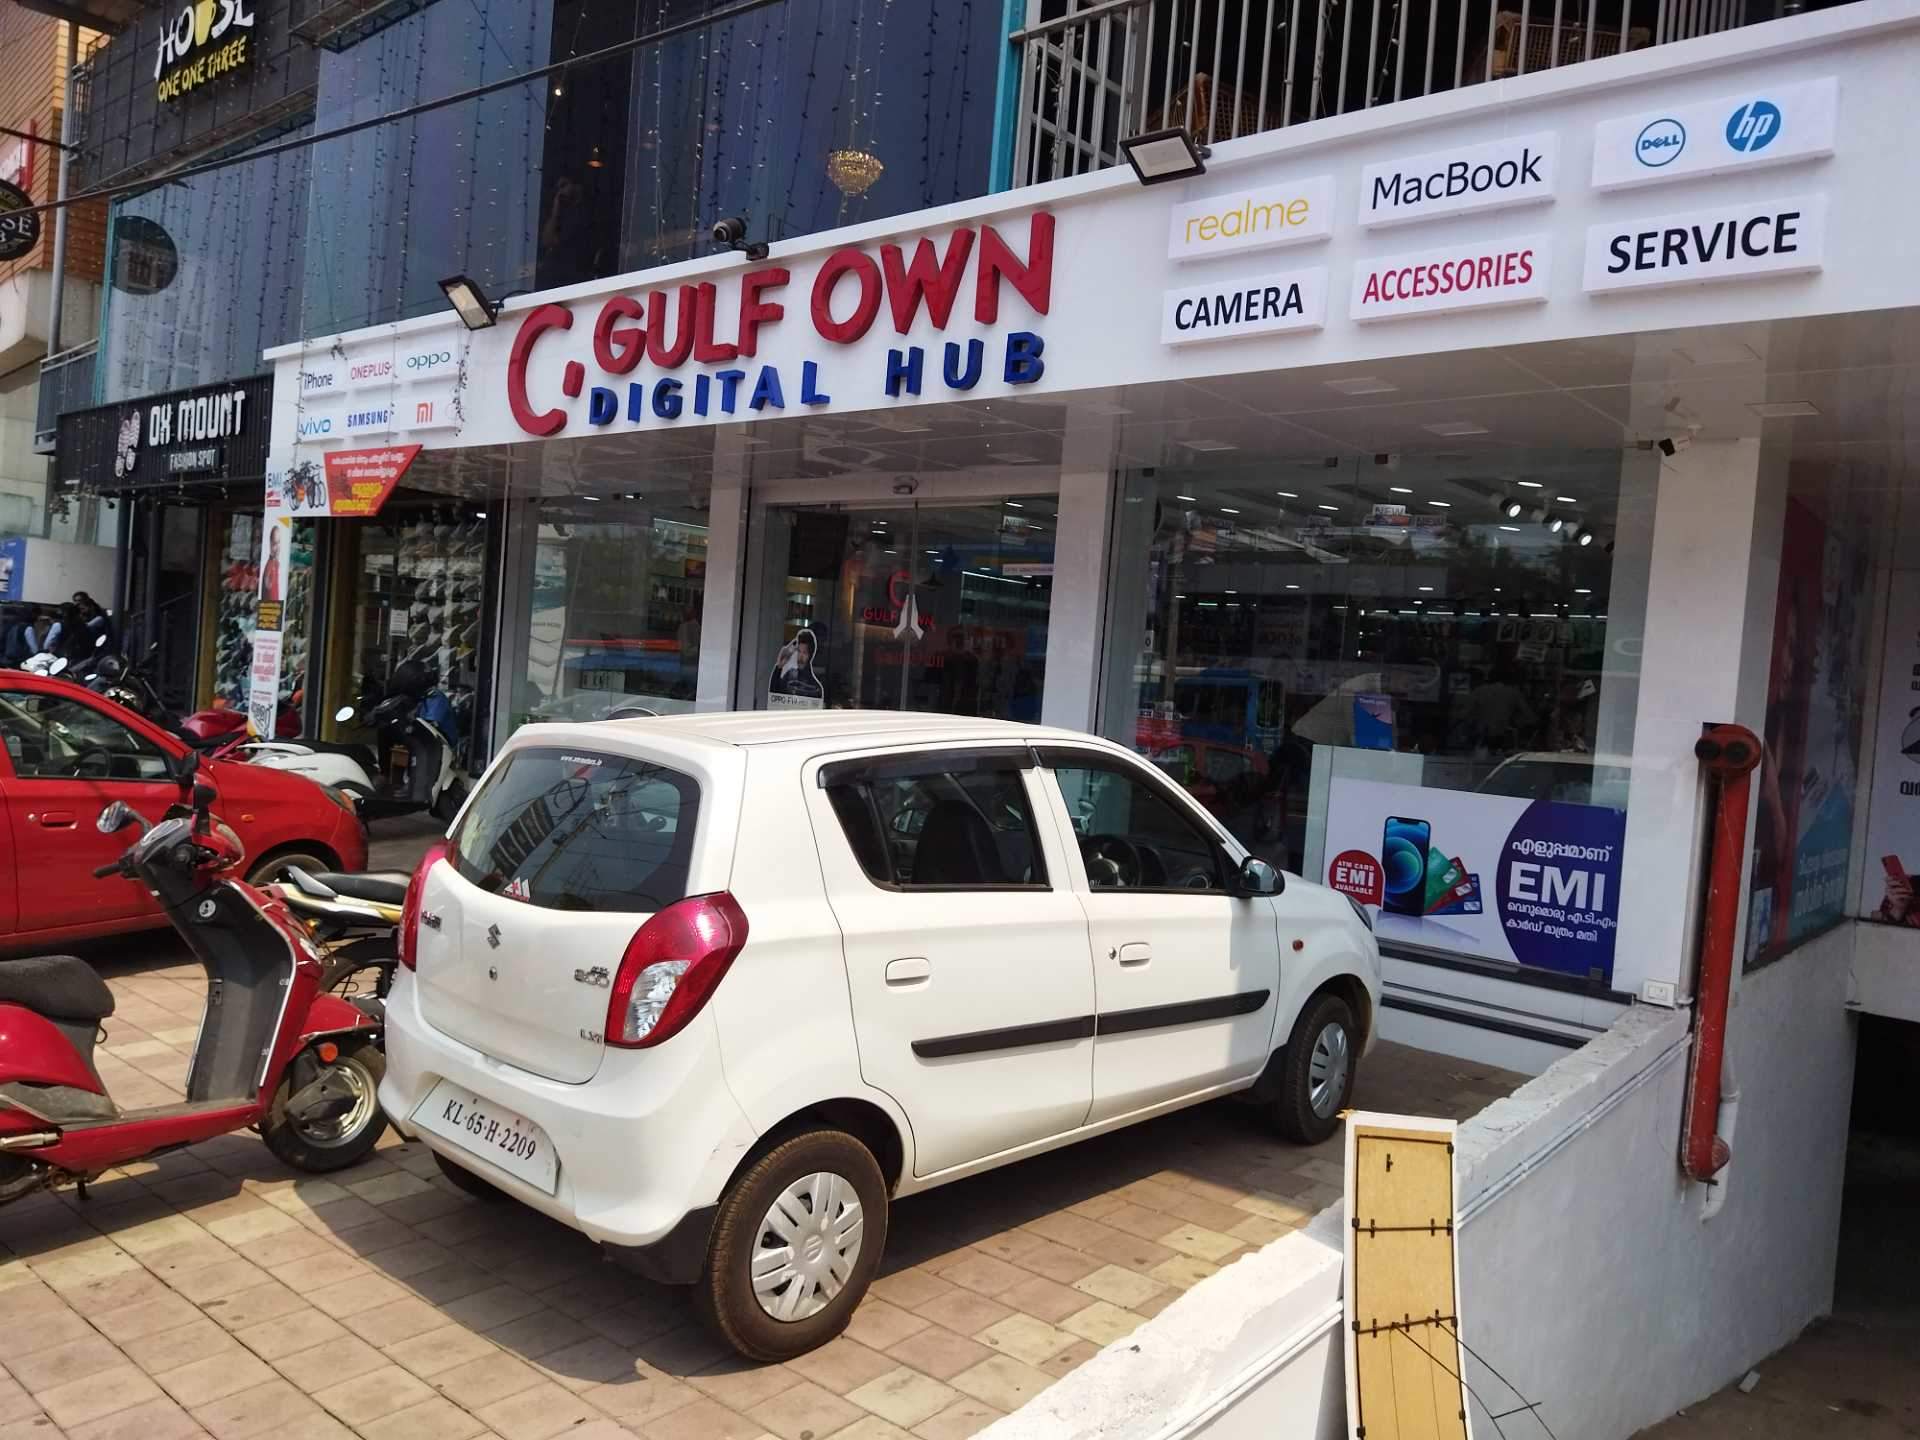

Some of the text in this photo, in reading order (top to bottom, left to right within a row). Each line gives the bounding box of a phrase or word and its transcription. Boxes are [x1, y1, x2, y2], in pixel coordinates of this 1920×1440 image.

[158, 35, 247, 102] ONE ONE THREE
[1730, 101, 1777, 152] hp
[1371, 148, 1543, 210] MacBook
[1185, 199, 1310, 244] realme
[1607, 211, 1801, 275] SERVICE
[593, 267, 790, 375] GULF
[810, 211, 1056, 345] OWN
[1362, 250, 1533, 304] ACCESSORIES
[1175, 282, 1304, 330] CAMERA
[304, 372, 333, 390] iPhone
[589, 331, 1045, 427] DIGITAL HUB
[177, 390, 246, 443] MOUNT
[300, 418, 332, 435] vivo
[347, 410, 388, 428] SAMSUNG
[1335, 883, 1373, 896] AVAILABLE
[1336, 867, 1374, 888] EMI
[1337, 860, 1375, 872] ATM CARD
[1509, 861, 1606, 912] EMI
